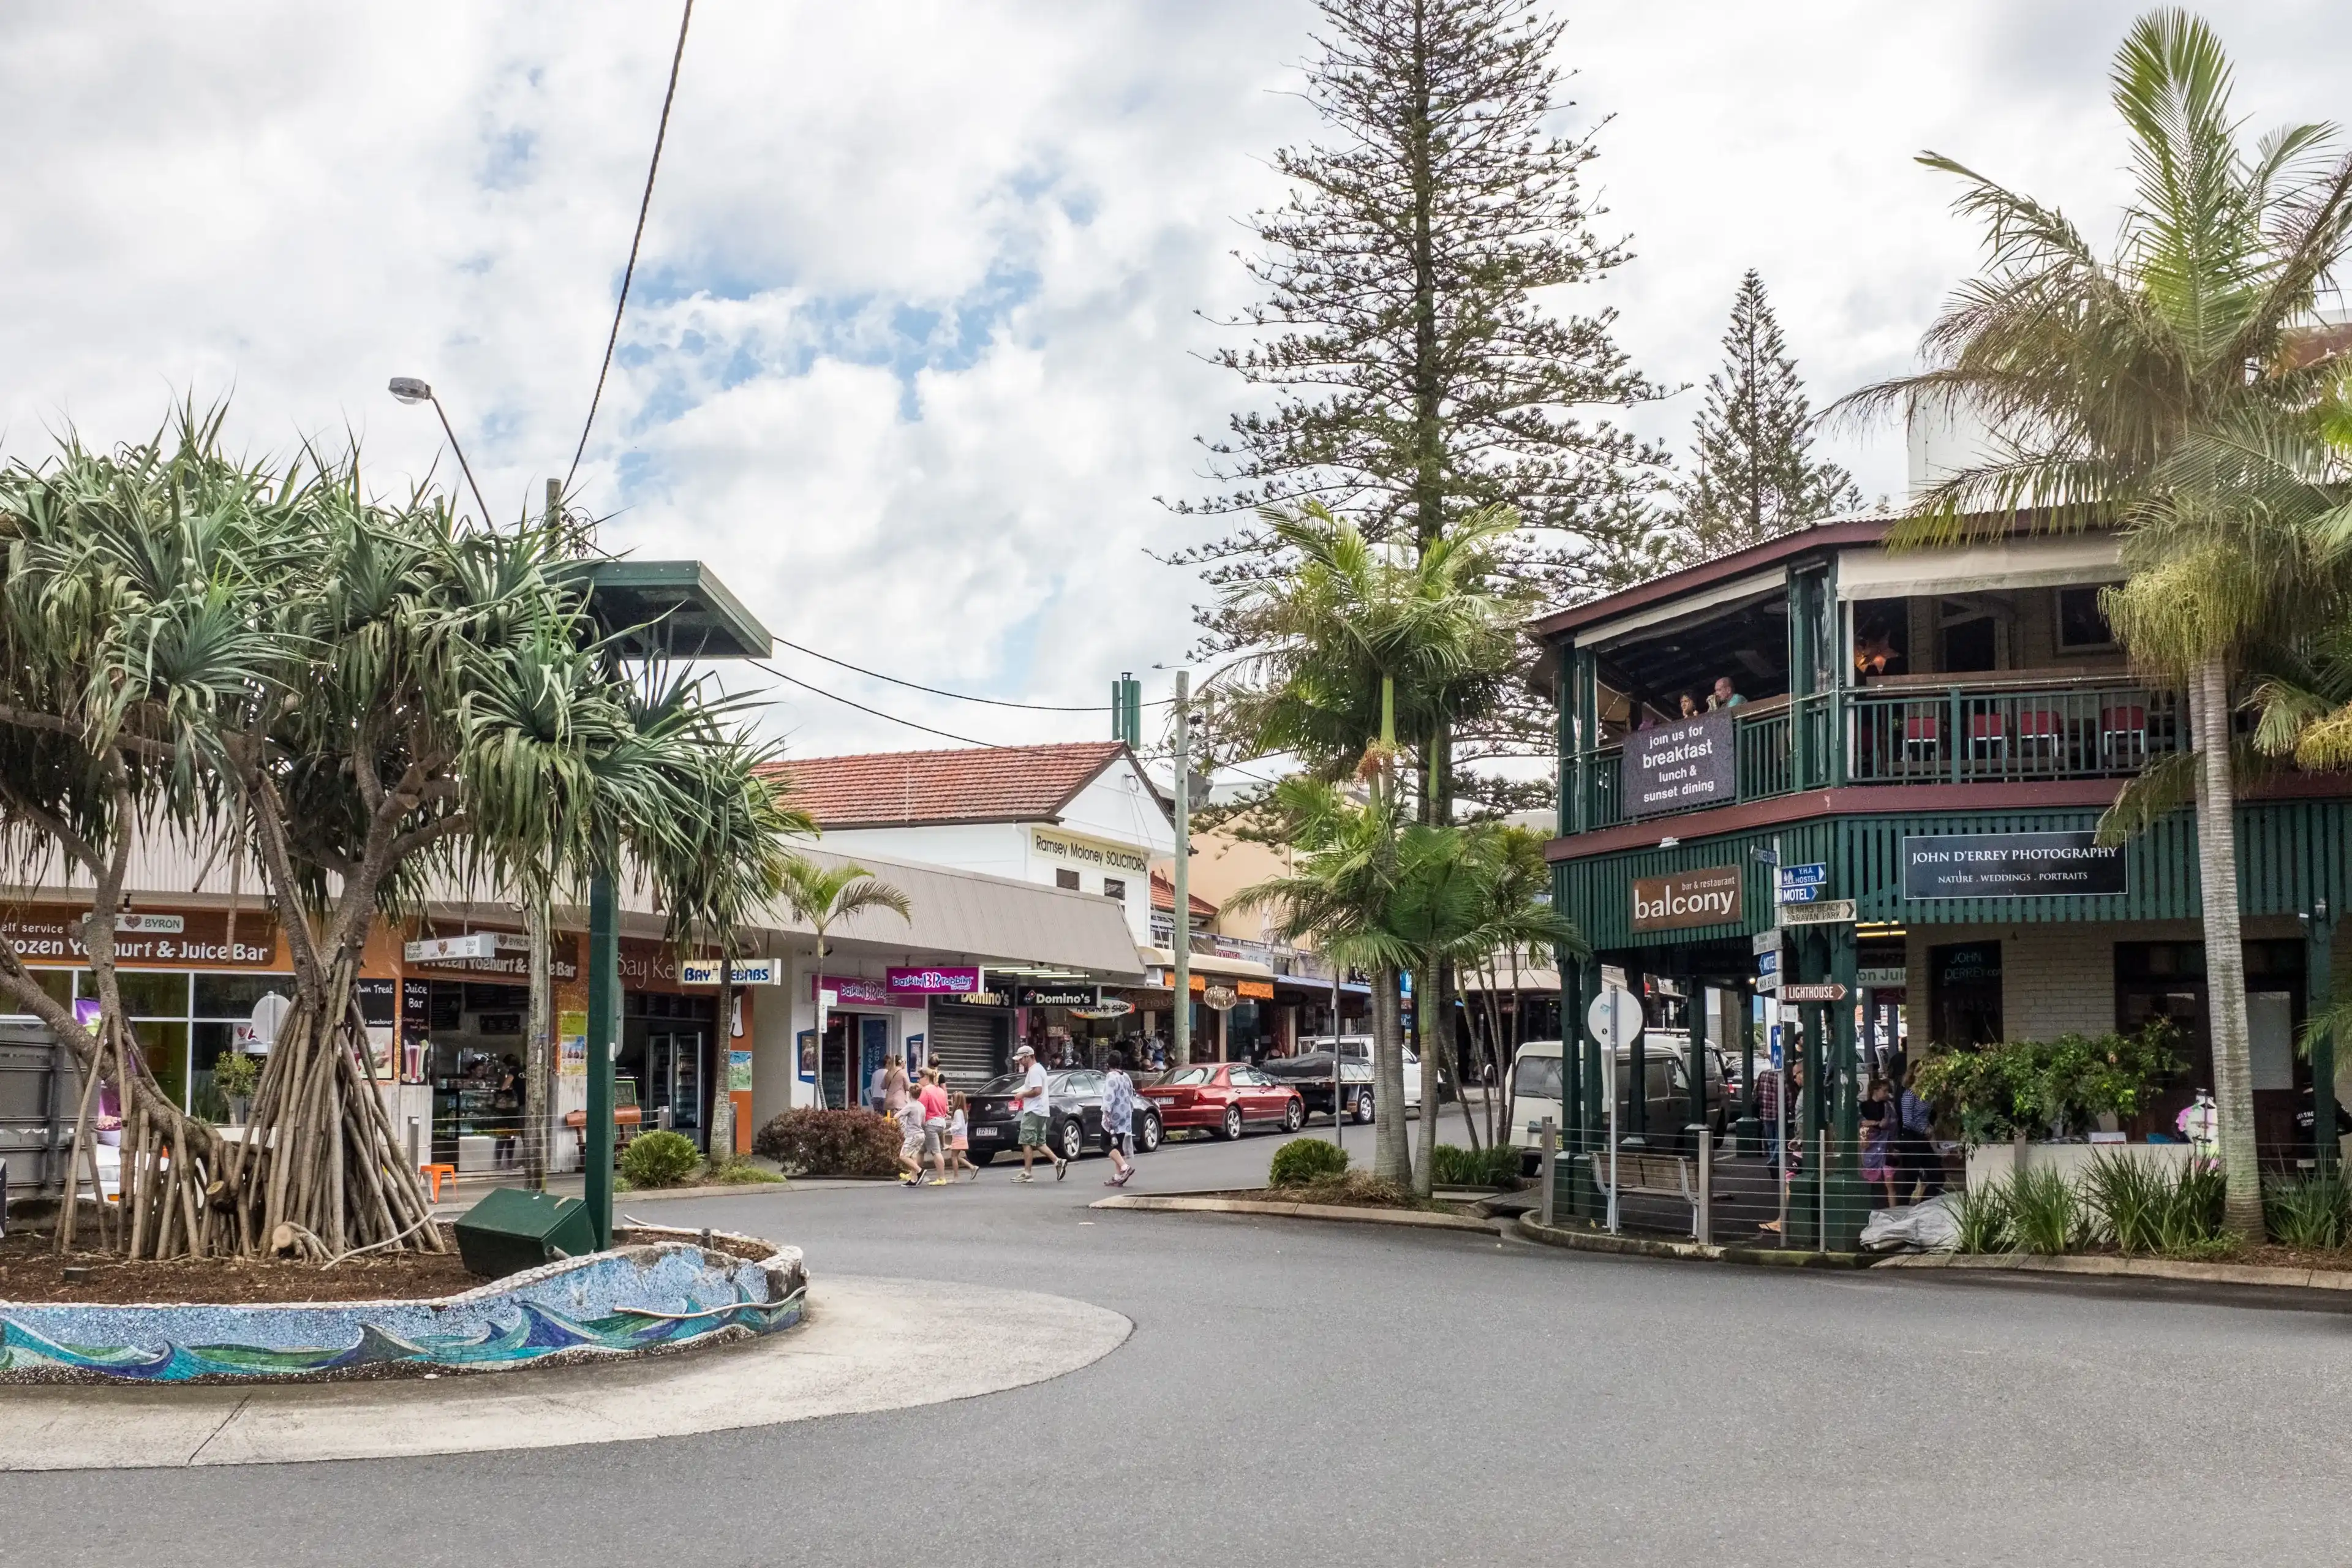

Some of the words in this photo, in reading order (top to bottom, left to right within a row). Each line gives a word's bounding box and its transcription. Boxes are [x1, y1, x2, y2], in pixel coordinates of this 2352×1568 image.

[1649, 736, 1668, 749] join
[1672, 731, 1684, 742] us
[1688, 726, 1703, 737] for
[1643, 739, 1713, 769] breakfast
[1659, 767, 1687, 782] lunch
[1689, 764, 1697, 777] &
[1643, 786, 1678, 802] sunset
[1682, 780, 1714, 795] dining
[1036, 835, 1068, 859] Ramsey
[1071, 842, 1103, 866] Moloney
[1106, 850, 1147, 873] SOLICITORS
[1912, 852, 1949, 865] JOHN
[1954, 850, 2008, 862] D'ERREY
[2012, 846, 2118, 860] PHOTOGRAPHY
[1681, 882, 1692, 891] bar
[1700, 876, 1735, 888] restaurant
[1795, 875, 1817, 884] HOSTEL
[1981, 873, 2031, 882] WEDDINGS
[1634, 884, 1735, 919] balcony
[1783, 888, 1809, 902] MOTEL
[1787, 904, 1814, 915] CLARKS
[1817, 902, 1841, 913] BEACH
[1787, 913, 1819, 923] CARAVAN
[1823, 911, 1841, 920] PARK
[2, 923, 17, 932] elf
[21, 924, 64, 933] service
[145, 919, 180, 929] BYRON
[157, 940, 176, 958] &
[179, 941, 228, 960] Juice
[233, 943, 268, 961] Bar
[1950, 952, 1982, 965] JOHN
[514, 957, 527, 973] &
[557, 961, 576, 978] Bar
[684, 967, 710, 981] BAY
[892, 974, 922, 987] baskin
[922, 972, 941, 988] BR
[941, 975, 973, 986] robbins
[374, 984, 393, 993] Treat
[404, 983, 428, 994] Juice
[1789, 986, 1834, 999] LIGHTHOUSE
[409, 998, 423, 1008] Bar
[1036, 993, 1090, 1004] Domino's
[1112, 1004, 1129, 1012] SHOP
